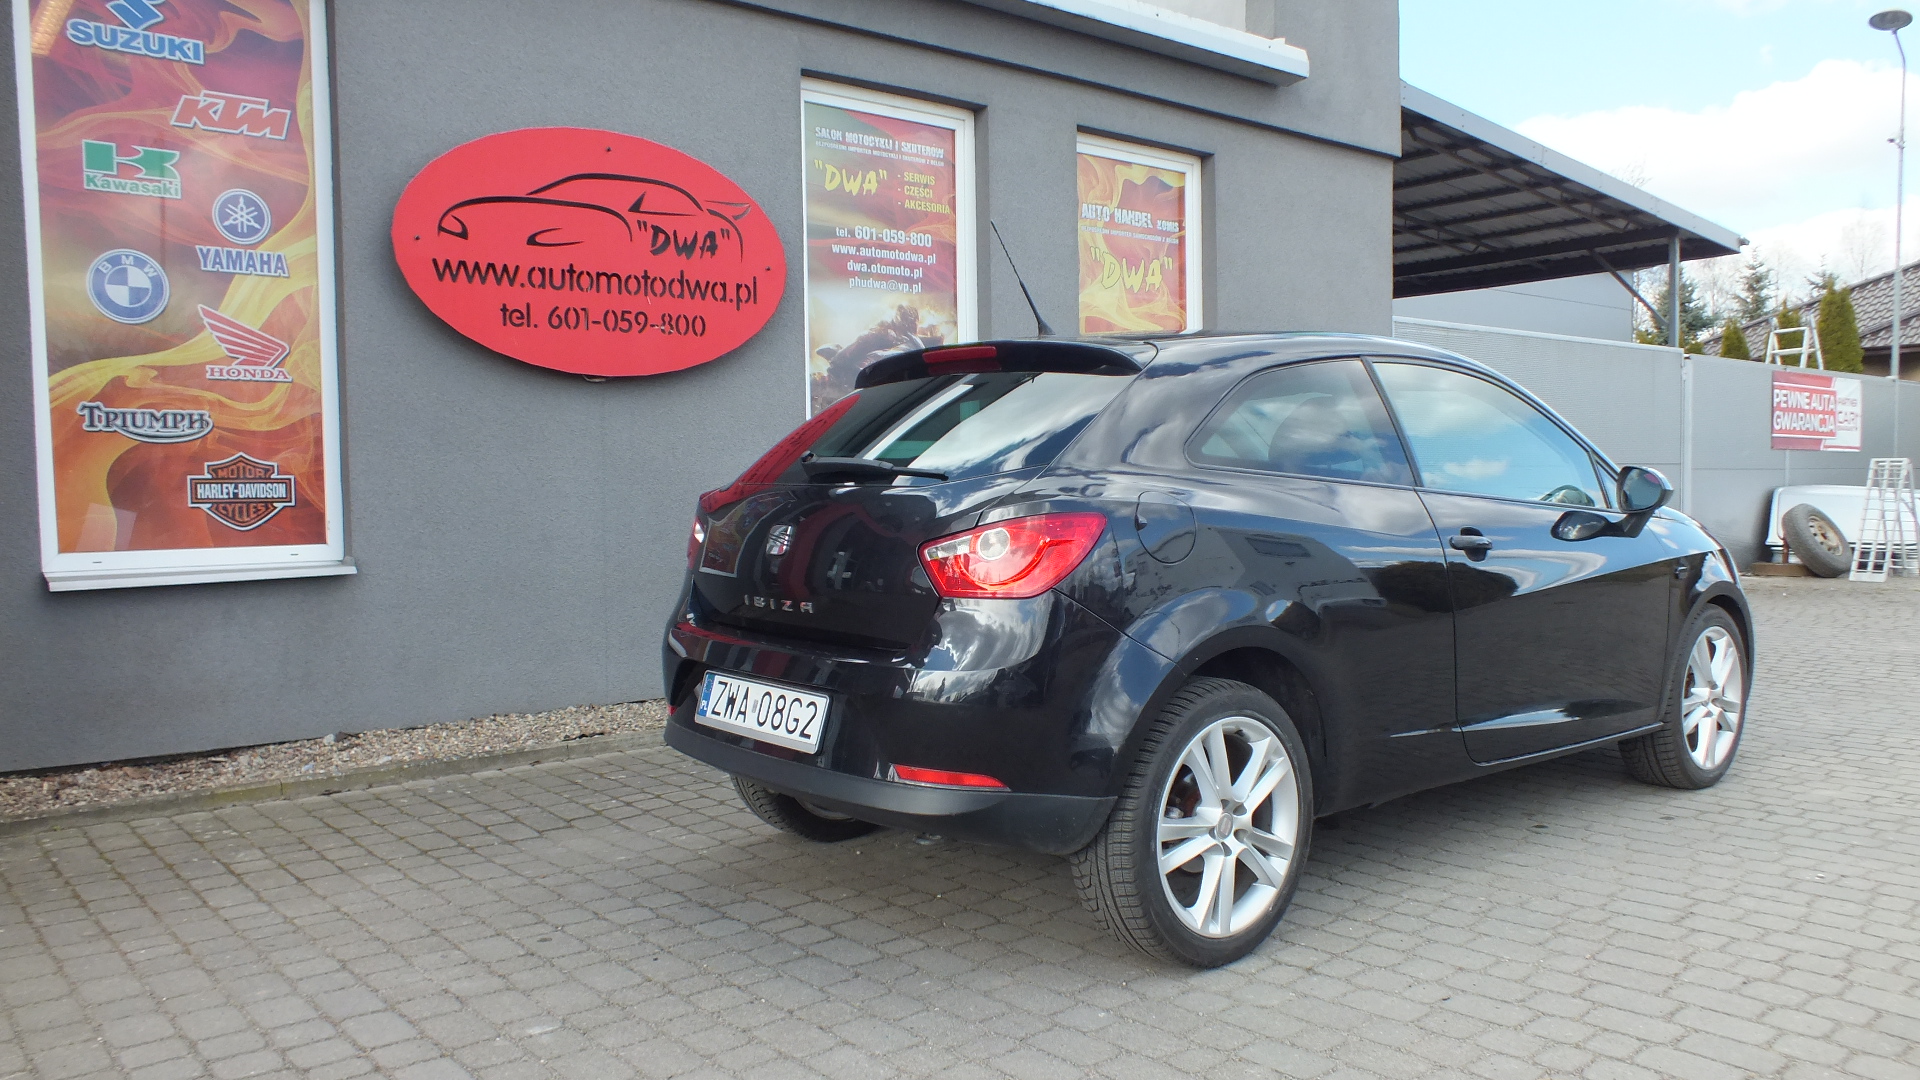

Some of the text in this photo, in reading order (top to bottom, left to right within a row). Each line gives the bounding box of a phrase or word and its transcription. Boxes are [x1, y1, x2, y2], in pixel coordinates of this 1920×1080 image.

[67, 20, 204, 64] SUZUKI
[170, 90, 291, 139] KTM
[815, 126, 944, 159] SALON MOTOCYKLI I SKUTERÓW
[85, 173, 181, 198] Kawasaki
[814, 159, 887, 196] "DWA"
[904, 171, 935, 185] SERWIS
[904, 185, 933, 199] CZĘŚCI
[904, 200, 951, 214] AKCESORIA
[1081, 203, 1111, 222] AUTO
[1114, 207, 1153, 228] HANDEL
[637, 219, 731, 259] "DWA"
[836, 225, 932, 248] tel. 601-059-800
[196, 245, 289, 277] YAMAHA
[832, 243, 936, 264] www.automotodwa.pl
[97, 255, 158, 277] BMW
[847, 260, 923, 279] dwa.otomoto.pl
[432, 258, 758, 310] www.automotodwa.pl
[849, 277, 922, 294] phudwa@vp.pl
[500, 302, 707, 337] tel. 601-059-800
[206, 366, 291, 381] HONDA
[1773, 389, 1836, 412] PEWNE AUTA
[77, 402, 213, 433] TRIUMPH
[1773, 410, 1836, 432] GWARANCJA
[217, 464, 267, 478] MOTOR
[196, 483, 287, 499] HARLEY-DAVIDSON
[217, 503, 266, 521] CYCLES
[744, 594, 815, 614] IBIZA
[700, 680, 818, 740] PL ZWA 08G2
